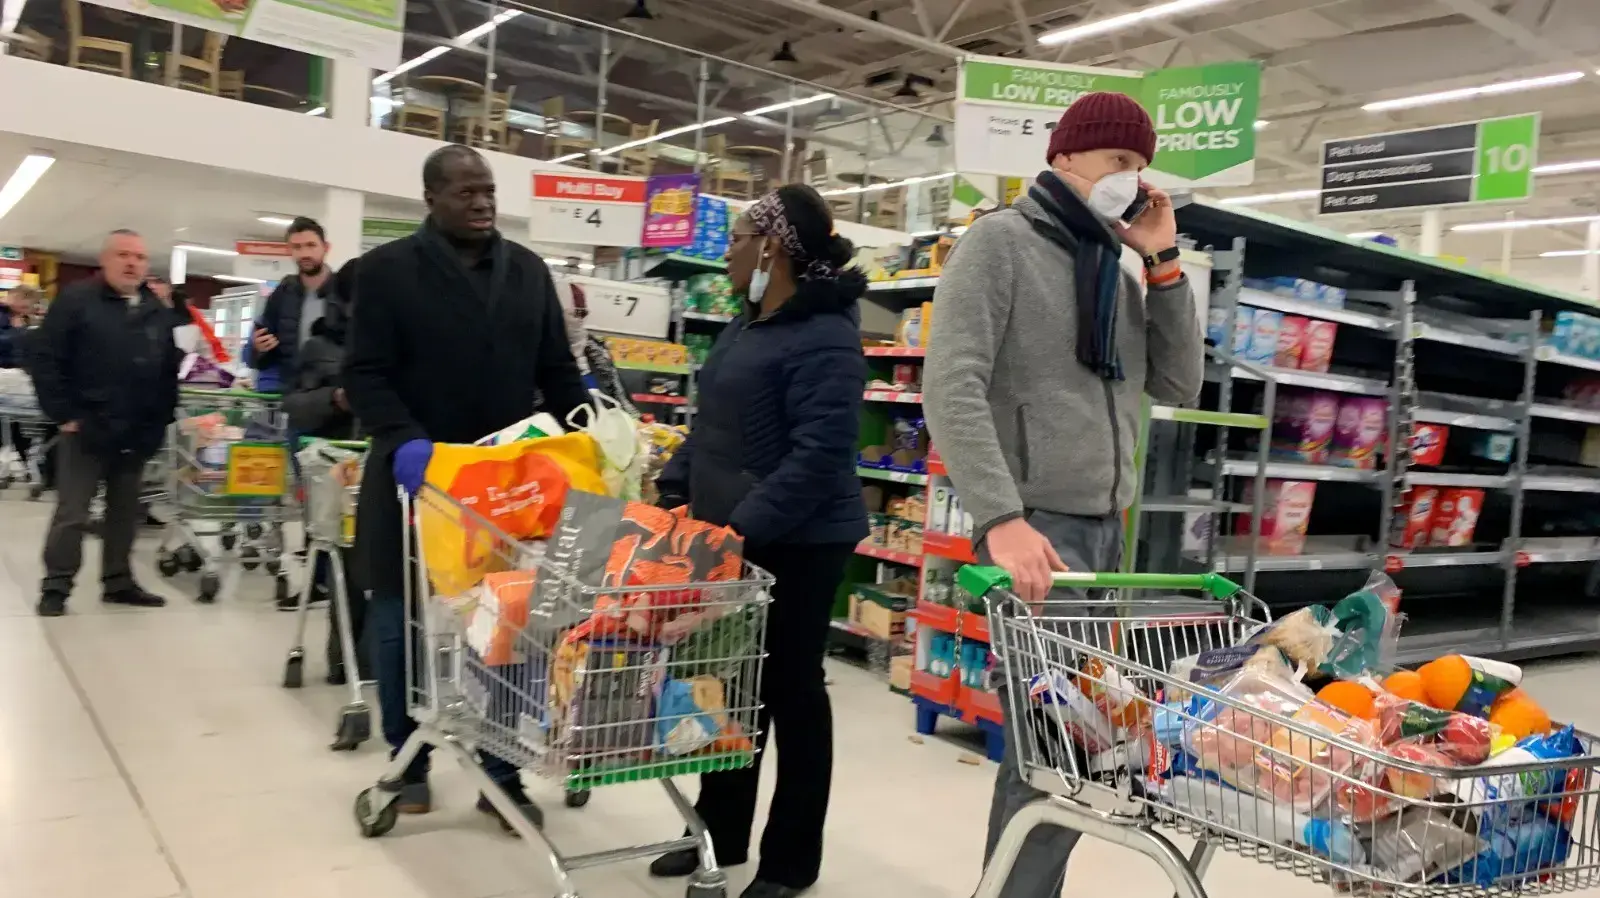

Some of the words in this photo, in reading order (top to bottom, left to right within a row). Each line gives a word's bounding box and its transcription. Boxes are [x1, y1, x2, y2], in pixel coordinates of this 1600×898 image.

[1011, 69, 1096, 89] FAMOUSLY
[992, 82, 1040, 102] LOW
[1159, 82, 1245, 100] FAMOUSLY
[1155, 98, 1243, 130] LOW
[1154, 129, 1242, 153] PRICES
[1328, 146, 1352, 158] Pet
[1352, 141, 1386, 156] food
[1485, 143, 1528, 174] 10
[1326, 171, 1355, 183] Dog
[1355, 163, 1434, 180] accessories
[556, 181, 593, 196] Multi
[594, 183, 625, 200] Buy
[1323, 195, 1347, 208] Pet
[1347, 193, 1378, 206] care
